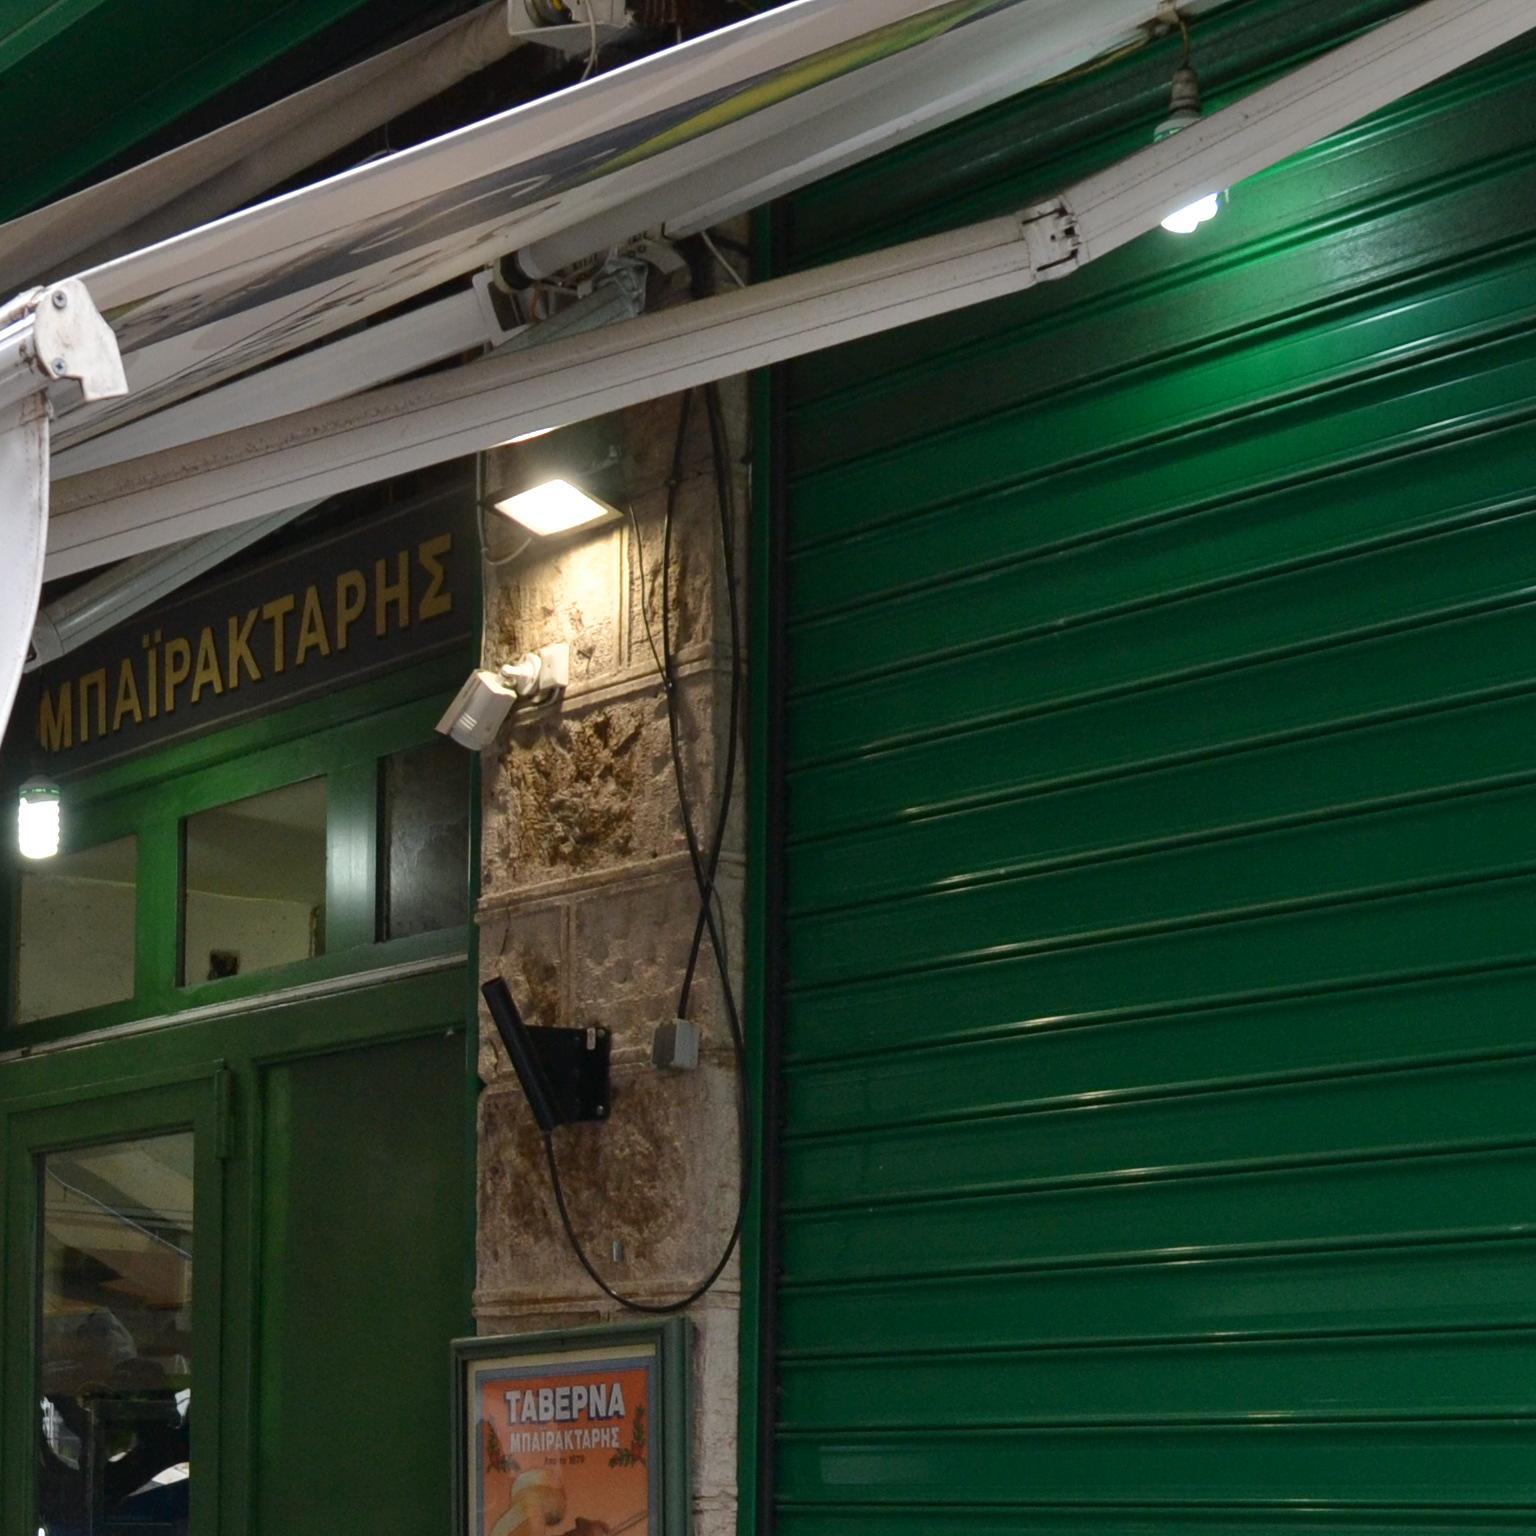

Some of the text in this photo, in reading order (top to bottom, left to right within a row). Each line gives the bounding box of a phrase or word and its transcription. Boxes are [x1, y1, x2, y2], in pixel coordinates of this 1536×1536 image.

[38, 532, 454, 755] ΜΠΑΪΡΑΚΤΑΡΗΣ
[504, 1382, 626, 1425] ΤΑΒΕΡΝΑ
[509, 1426, 621, 1455] ΜΠΑΪΡΑΚΤΑΡΗΣ
